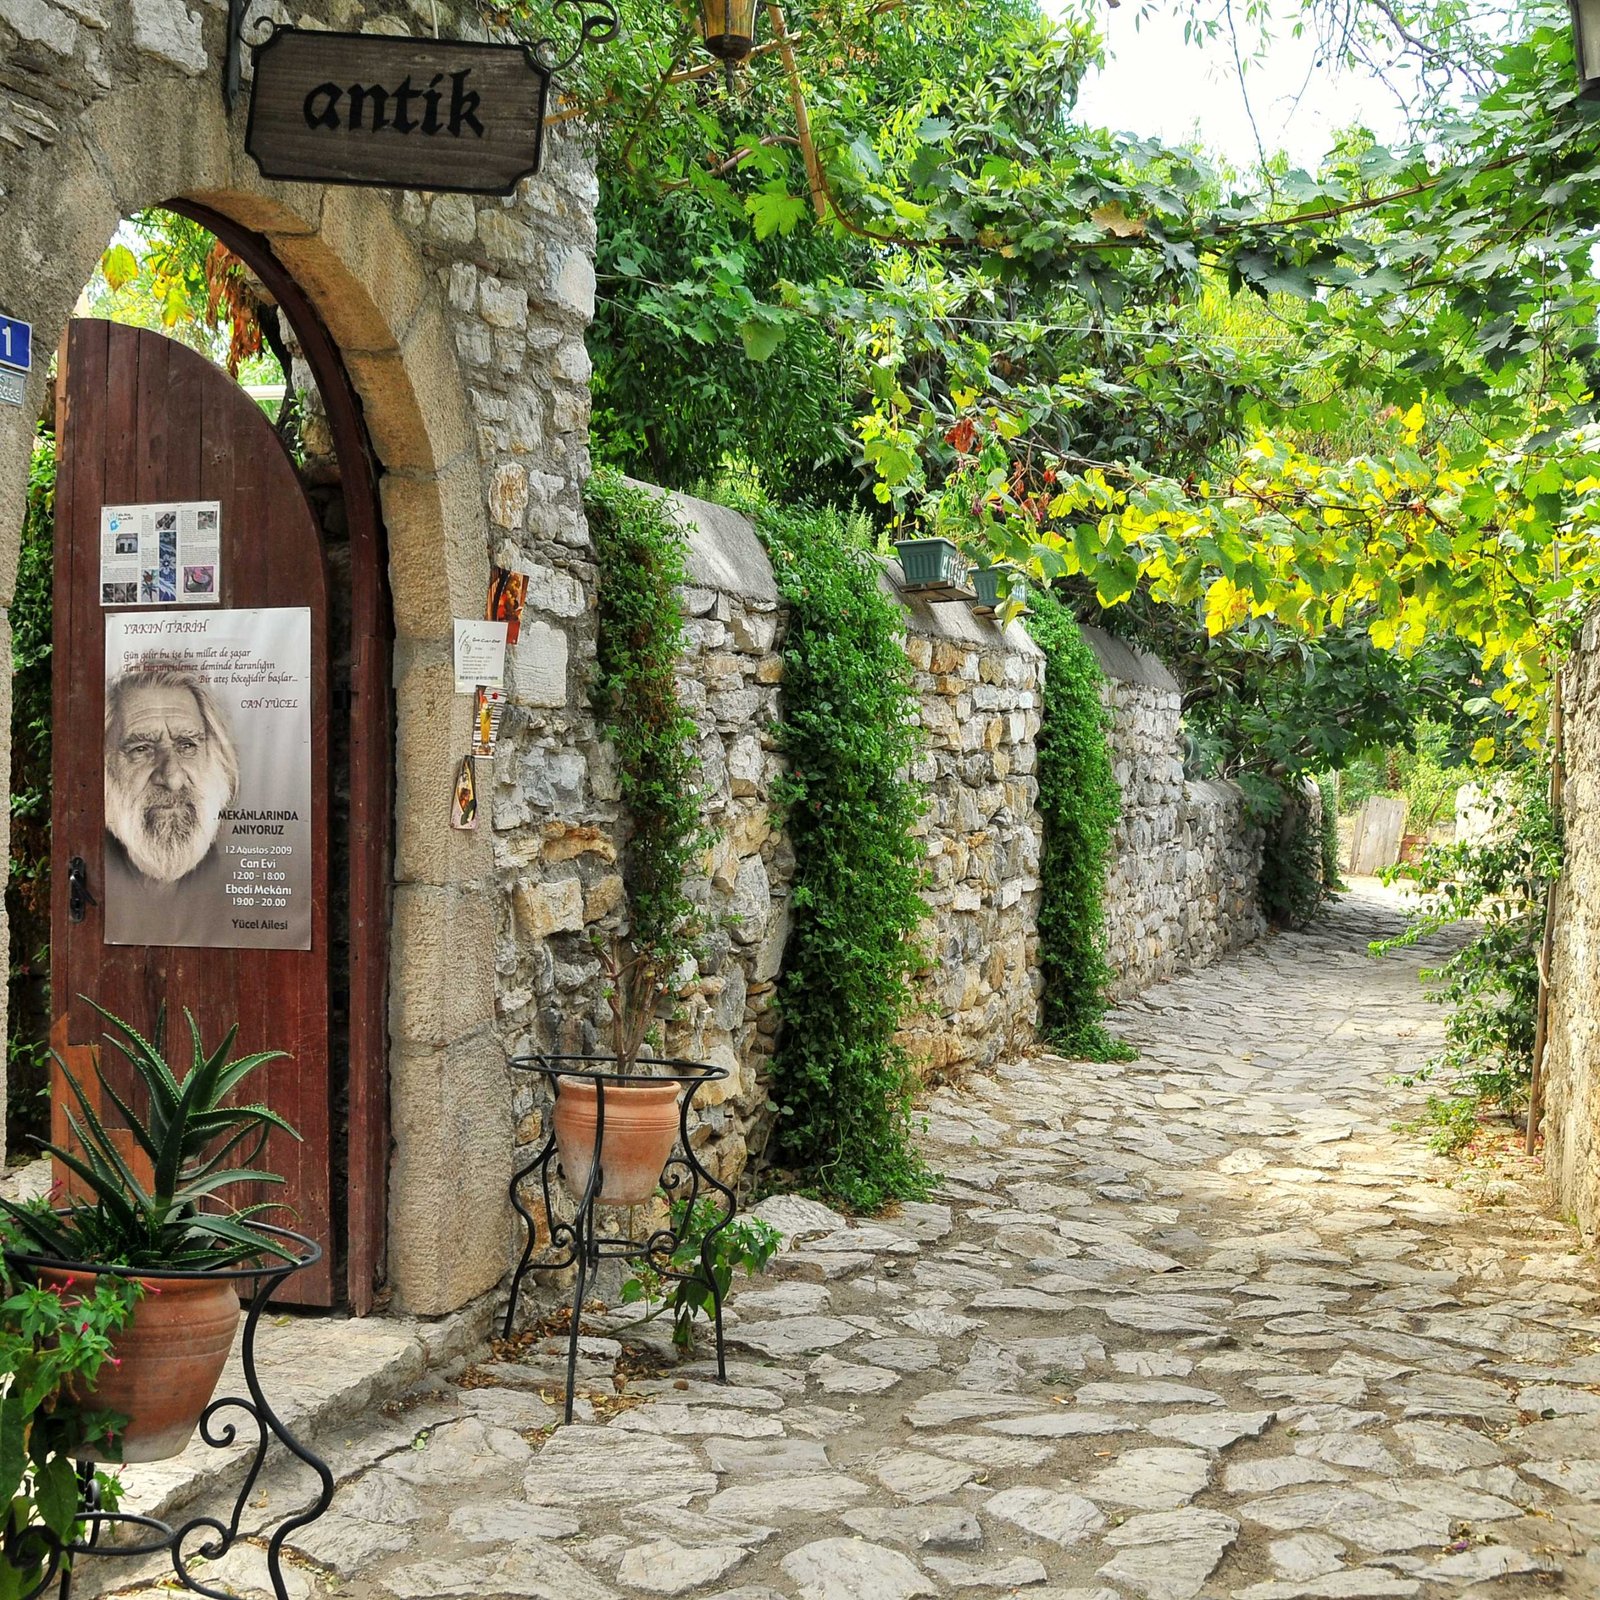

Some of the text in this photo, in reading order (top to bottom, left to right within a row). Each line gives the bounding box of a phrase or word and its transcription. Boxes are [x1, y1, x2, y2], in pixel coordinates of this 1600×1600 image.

[303, 68, 485, 137] antik
[124, 618, 210, 634] YAKIN TARİH
[123, 650, 139, 662] Gün
[140, 648, 158, 663] gelir
[160, 648, 170, 659] bu
[184, 648, 194, 658] bu
[196, 647, 217, 658] millet
[219, 647, 228, 658] de
[230, 649, 251, 660] şaşar
[200, 660, 232, 671] deminde
[234, 659, 275, 674] karanlığın
[199, 674, 211, 684] Bir
[213, 675, 229, 685] ateş
[231, 672, 266, 687] böceğidir
[240, 697, 298, 709] CAN YÜCEL
[218, 808, 299, 821] MEKÂNLARINDA
[232, 824, 284, 835] ANIYORUZ
[225, 845, 293, 856] 12 Ağustos 2009
[240, 858, 276, 869] Can Evi
[225, 884, 253, 895] Ebedi
[231, 919, 288, 930] Yücel Ailesi
